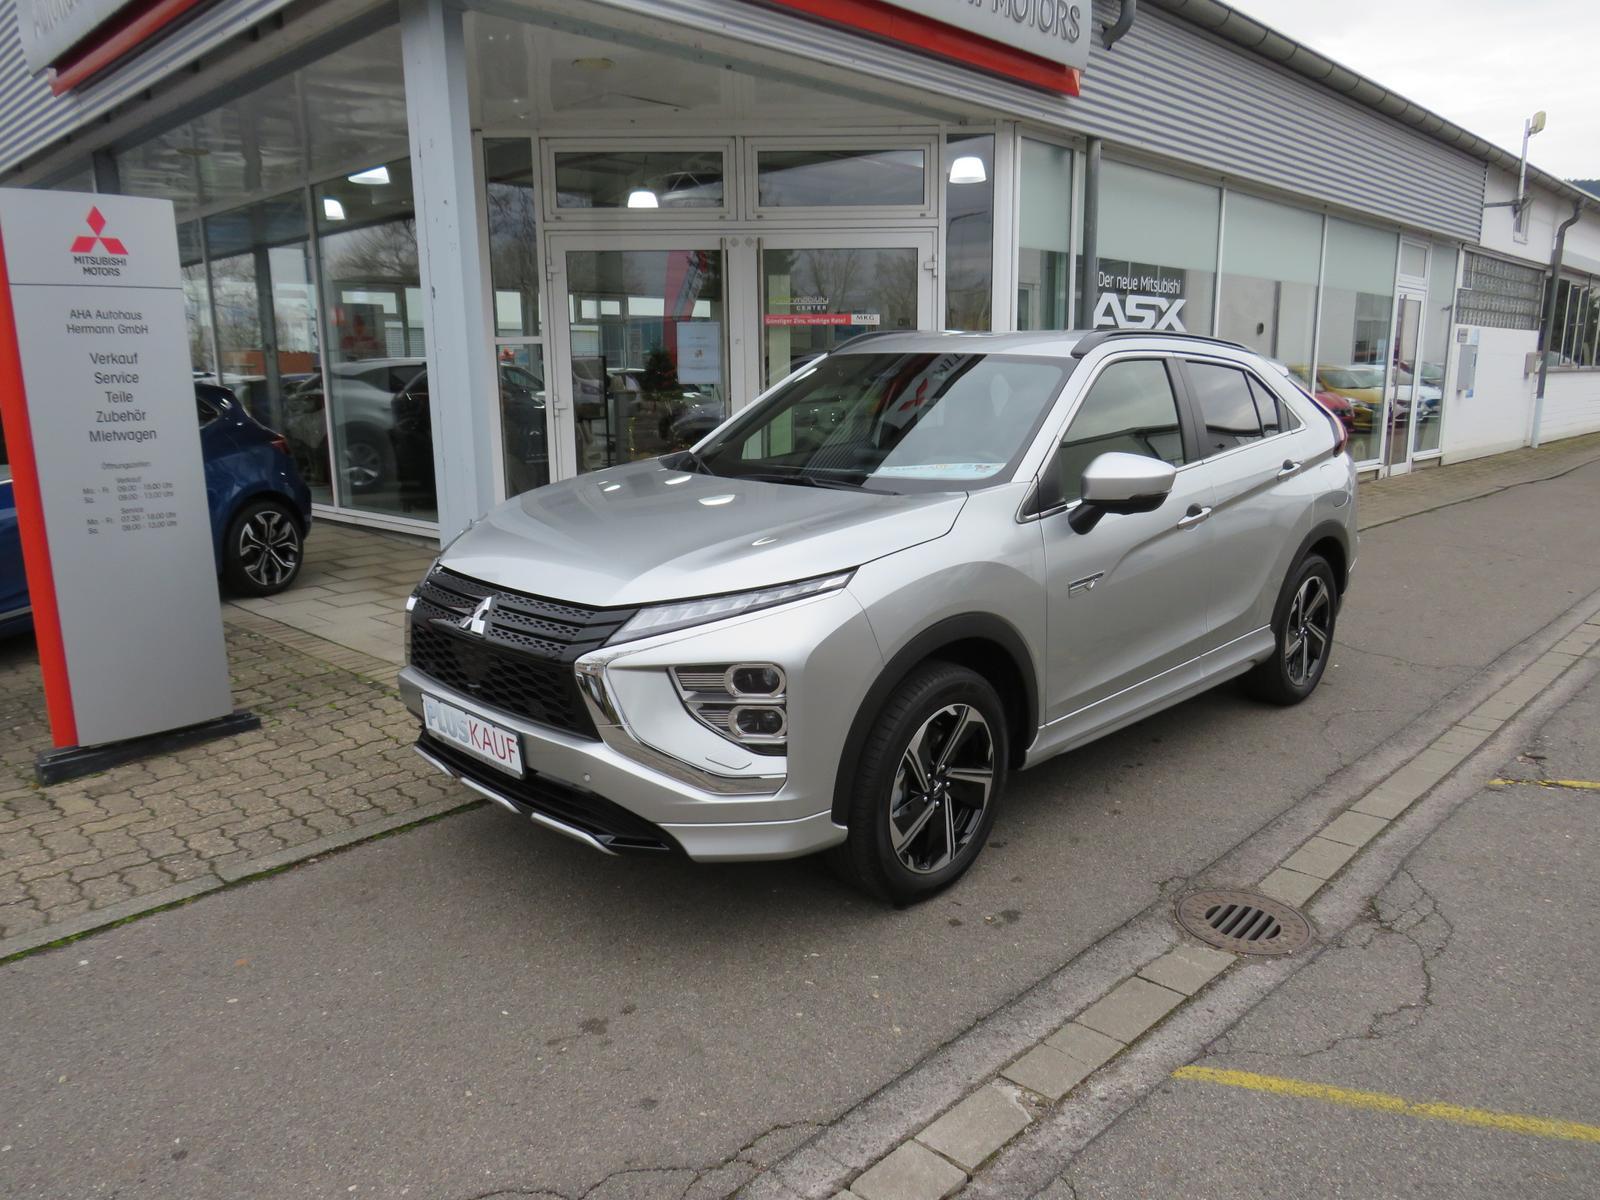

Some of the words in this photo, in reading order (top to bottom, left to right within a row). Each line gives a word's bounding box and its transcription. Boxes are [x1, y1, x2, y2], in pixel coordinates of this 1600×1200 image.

[73, 256, 127, 266] MITSUBISHI
[82, 267, 121, 276] MOTORS
[1098, 271, 1114, 287] Der
[1117, 275, 1138, 290] neue
[1140, 275, 1181, 294] Mitsubishi
[69, 309, 92, 320] AHA
[95, 309, 142, 321] Autohaus
[1093, 292, 1187, 332] ASX
[66, 323, 115, 335] Hermann
[117, 324, 149, 335] GmbH
[89, 352, 139, 366] Verkauf
[94, 371, 140, 385] Service
[105, 390, 134, 403] Teile
[95, 410, 147, 423] Zubehör
[88, 429, 157, 443] Mietwagen
